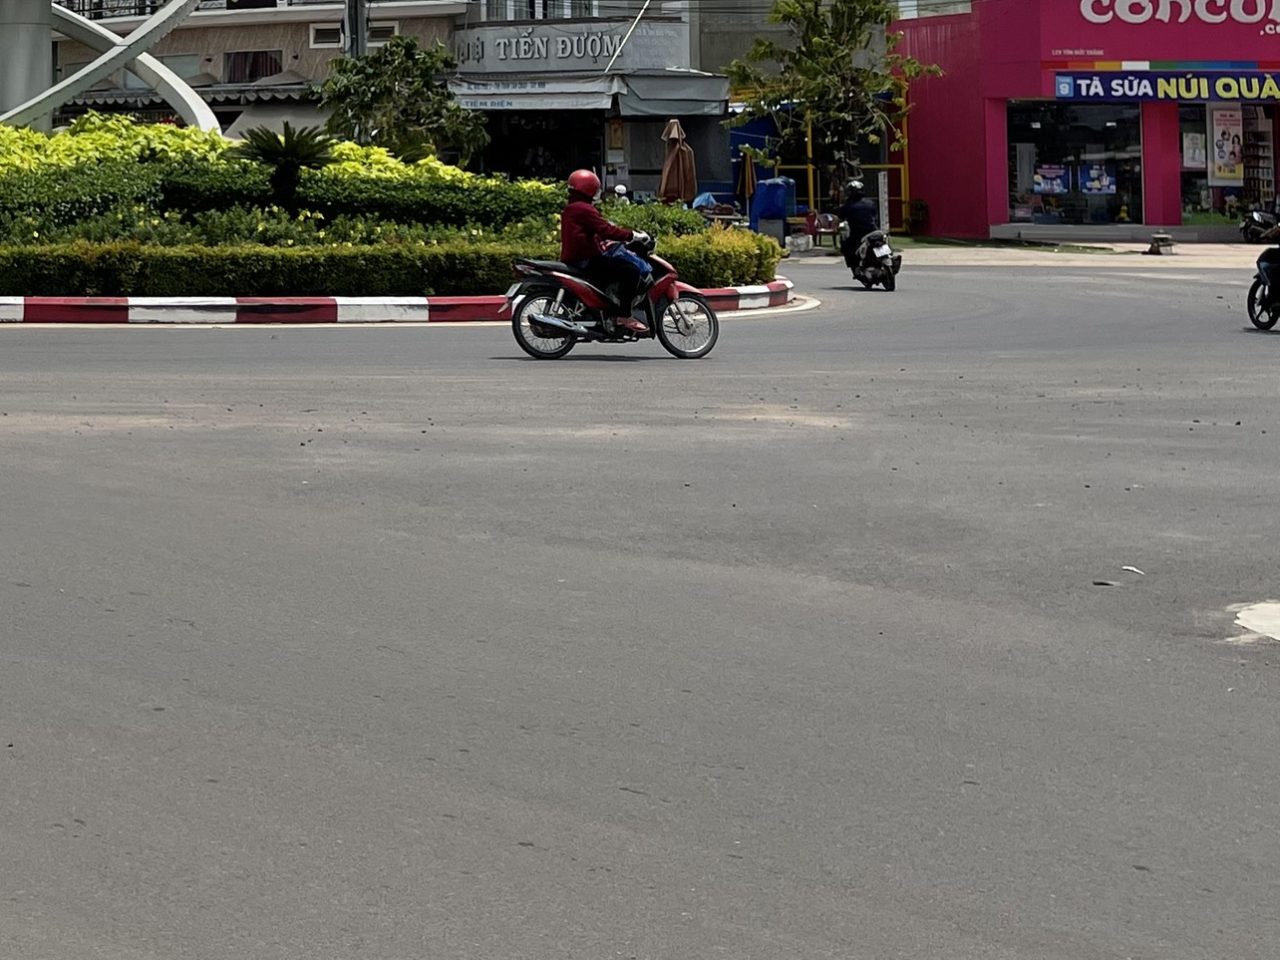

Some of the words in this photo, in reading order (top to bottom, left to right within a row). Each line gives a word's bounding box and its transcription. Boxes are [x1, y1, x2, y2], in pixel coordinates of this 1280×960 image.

[495, 27, 549, 61] TIẾN
[1076, 76, 1105, 97] TÃ
[1111, 76, 1154, 97] SỮA
[1157, 73, 1209, 99] NÚI
[1215, 73, 1280, 99] QUÀ
